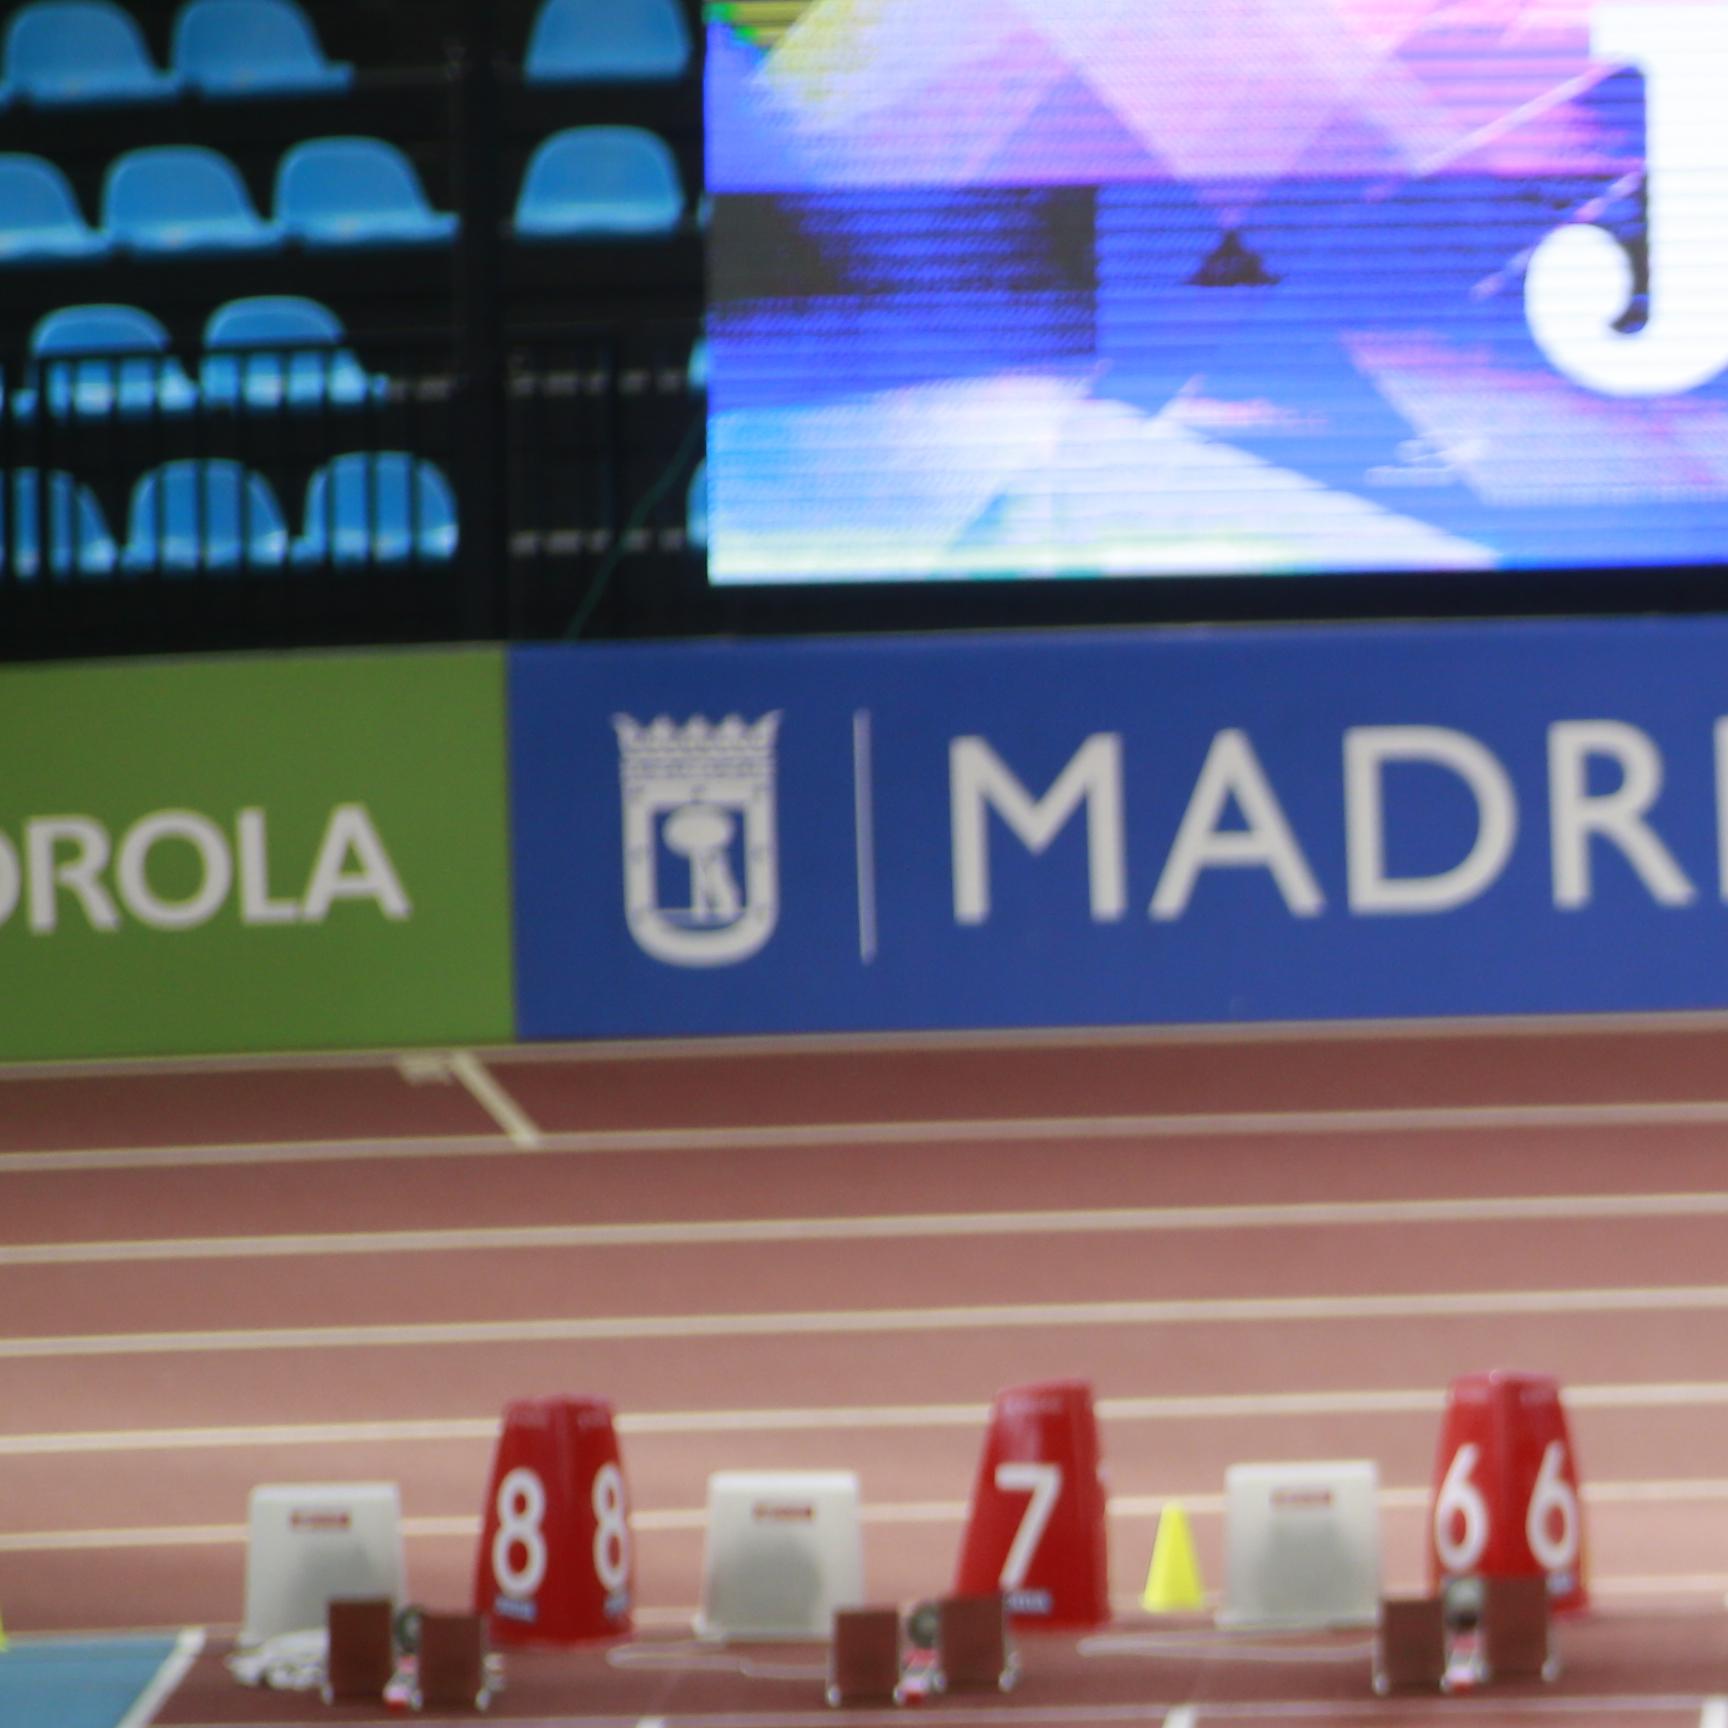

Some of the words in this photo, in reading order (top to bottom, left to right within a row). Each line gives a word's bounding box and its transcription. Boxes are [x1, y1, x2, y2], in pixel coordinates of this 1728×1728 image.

[492, 1465, 547, 1598] 8
[592, 1461, 631, 1593] 8
[995, 1464, 1062, 1590] 7
[1435, 1442, 1489, 1570] 6
[1526, 1440, 1581, 1571] 6
